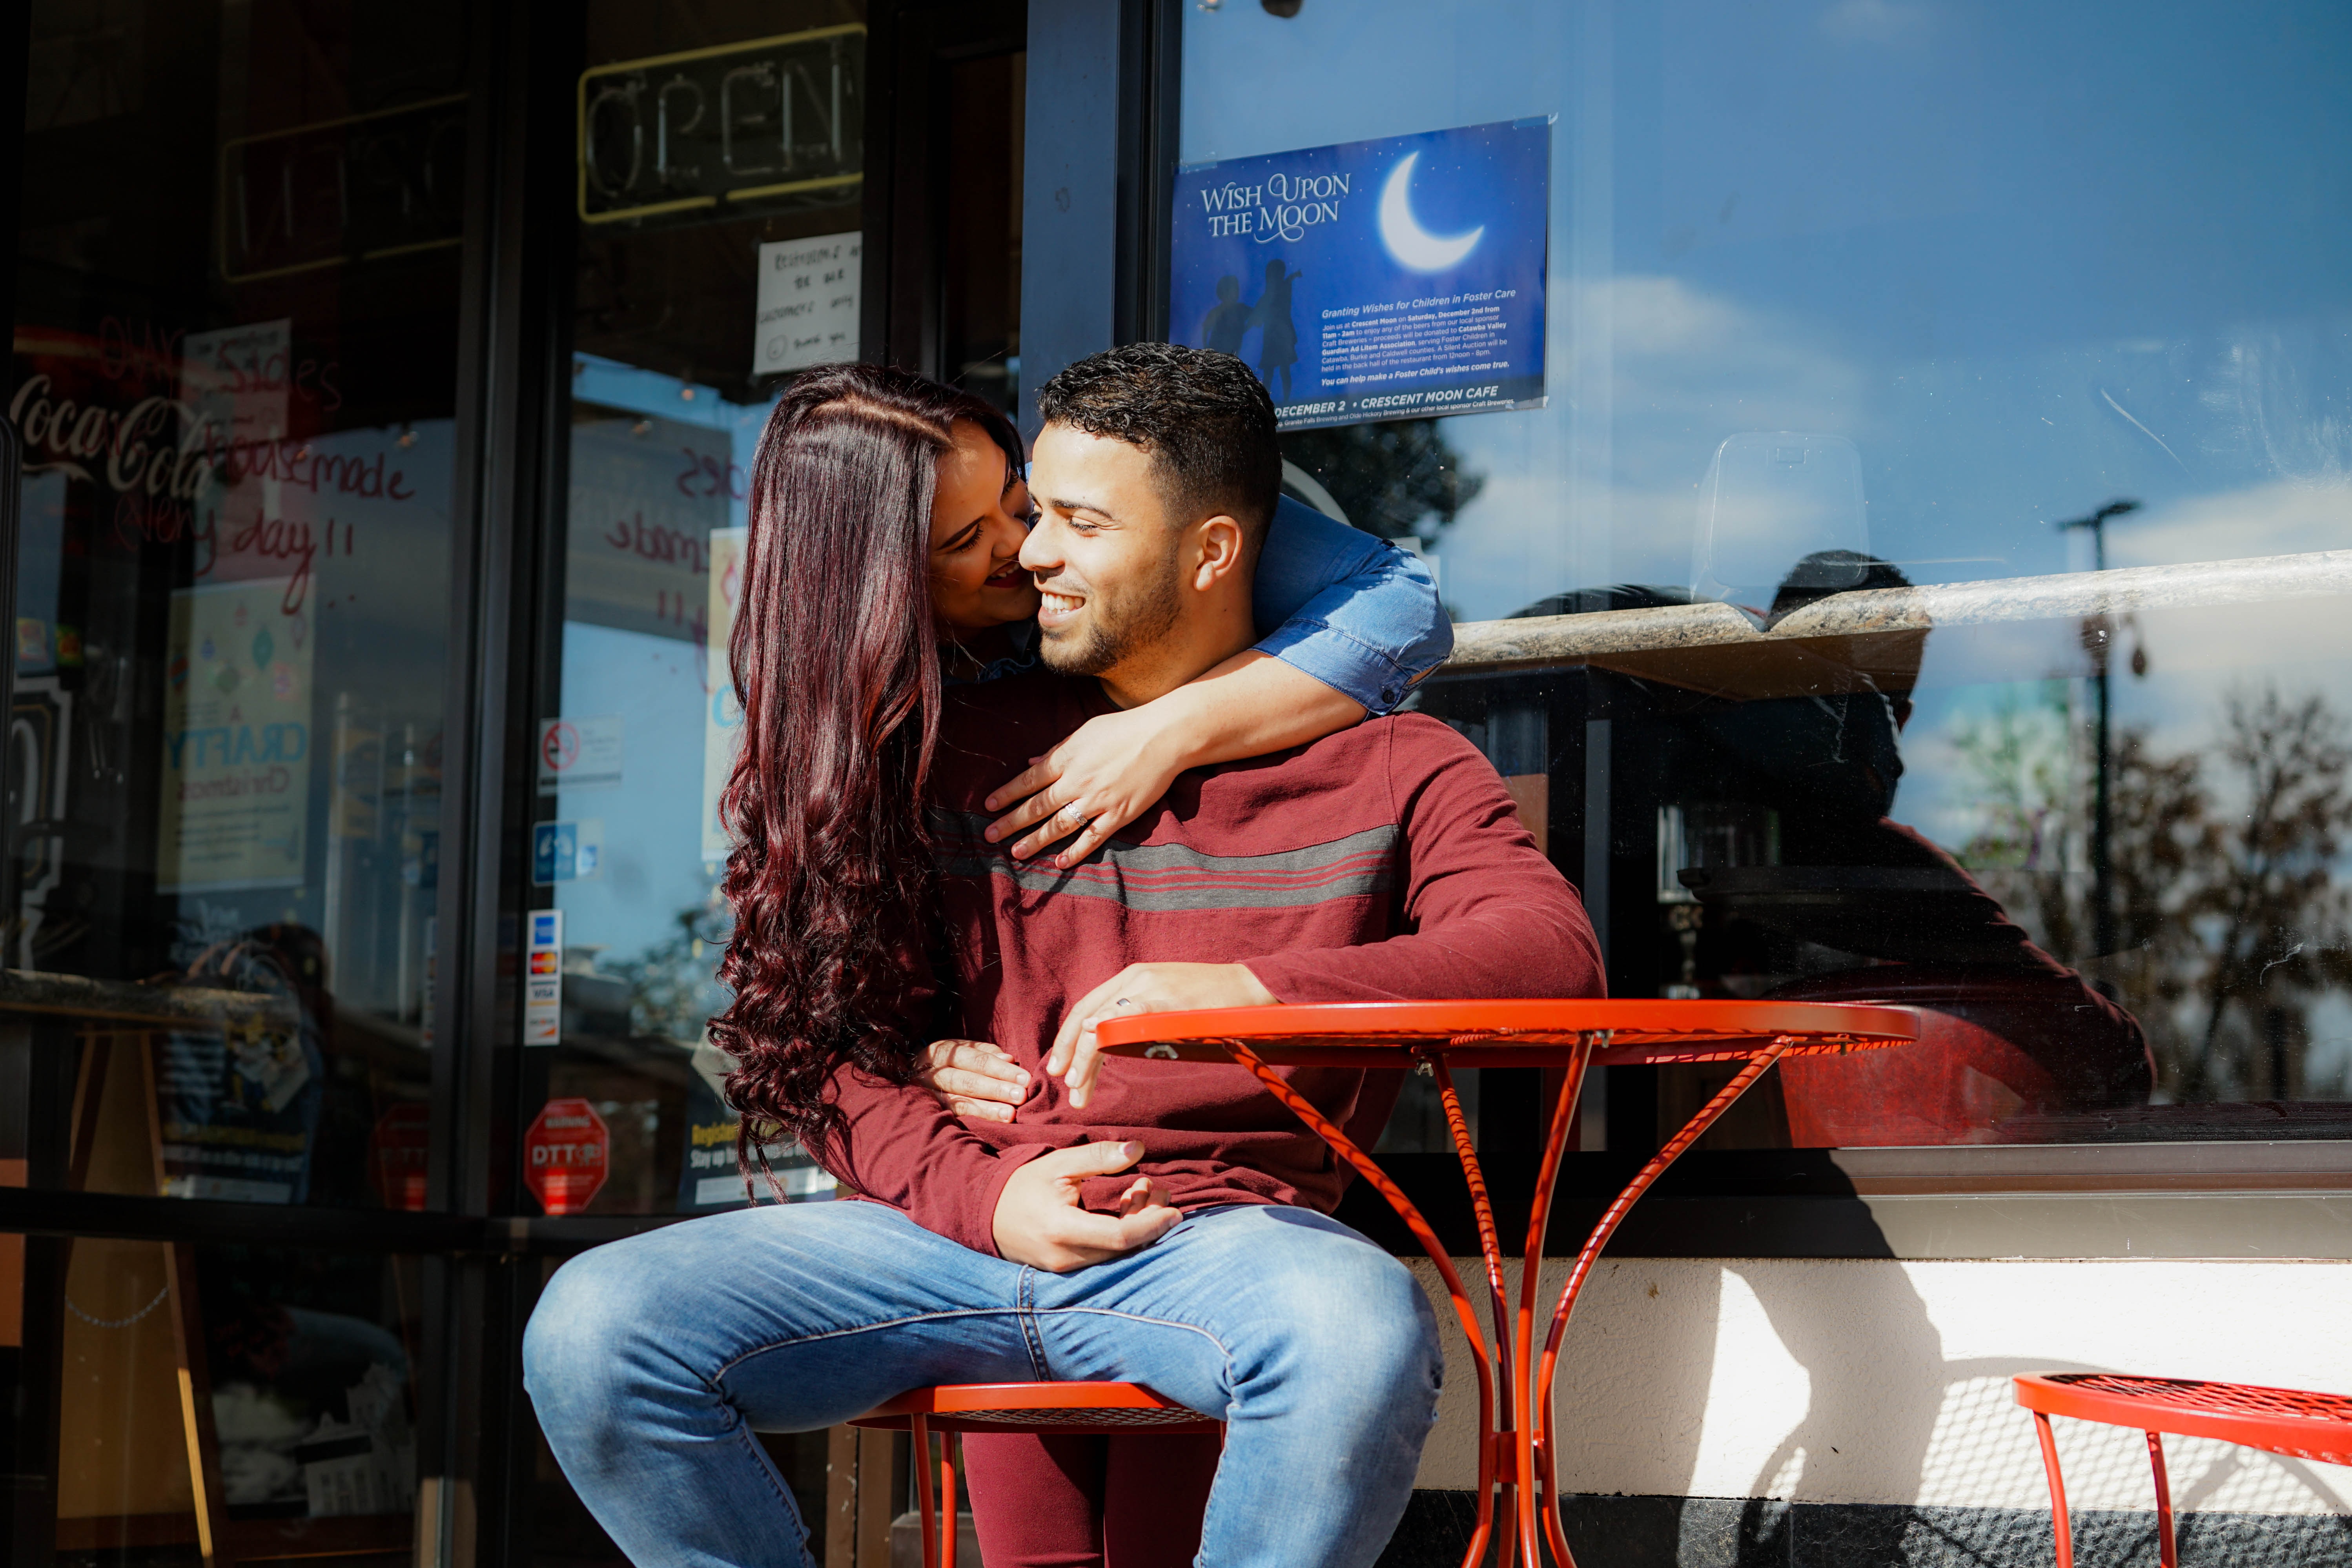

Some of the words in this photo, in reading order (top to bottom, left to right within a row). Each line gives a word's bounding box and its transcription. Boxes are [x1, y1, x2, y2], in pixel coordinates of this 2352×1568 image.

[586, 38, 843, 197] OPEN
[1200, 182, 1263, 213] WISH
[1268, 173, 1352, 202] UPON
[1208, 211, 1253, 237] THE
[1253, 200, 1340, 244] MOON
[1322, 307, 1360, 318] Granting
[1363, 303, 1394, 313] Wishes
[1396, 301, 1410, 310] for
[1413, 297, 1450, 308] Children
[1452, 295, 1461, 303] in
[1463, 292, 1492, 302] Foster
[1495, 289, 1516, 298] Care
[1438, 310, 1470, 318] December
[1475, 314, 1499, 323] sponsor
[1374, 333, 1401, 342] proceeds
[1380, 341, 1417, 349] Association,
[1409, 346, 1436, 354] counties.
[1401, 355, 1431, 363] restaurant
[1321, 379, 1335, 387] You
[1350, 375, 1366, 383] help
[1367, 373, 1387, 381] make
[1419, 367, 1443, 376] Child's
[1446, 364, 1470, 373] wishes
[1275, 401, 1335, 417] DECEMBER
[1338, 401, 1346, 411] 2
[1361, 393, 1423, 408] CRESCENT
[1425, 389, 1463, 402] MOON
[1466, 386, 1498, 398] CAFE
[534, 987, 554, 998] VISA
[690, 1148, 712, 1169] Stay
[712, 1150, 725, 1167] up
